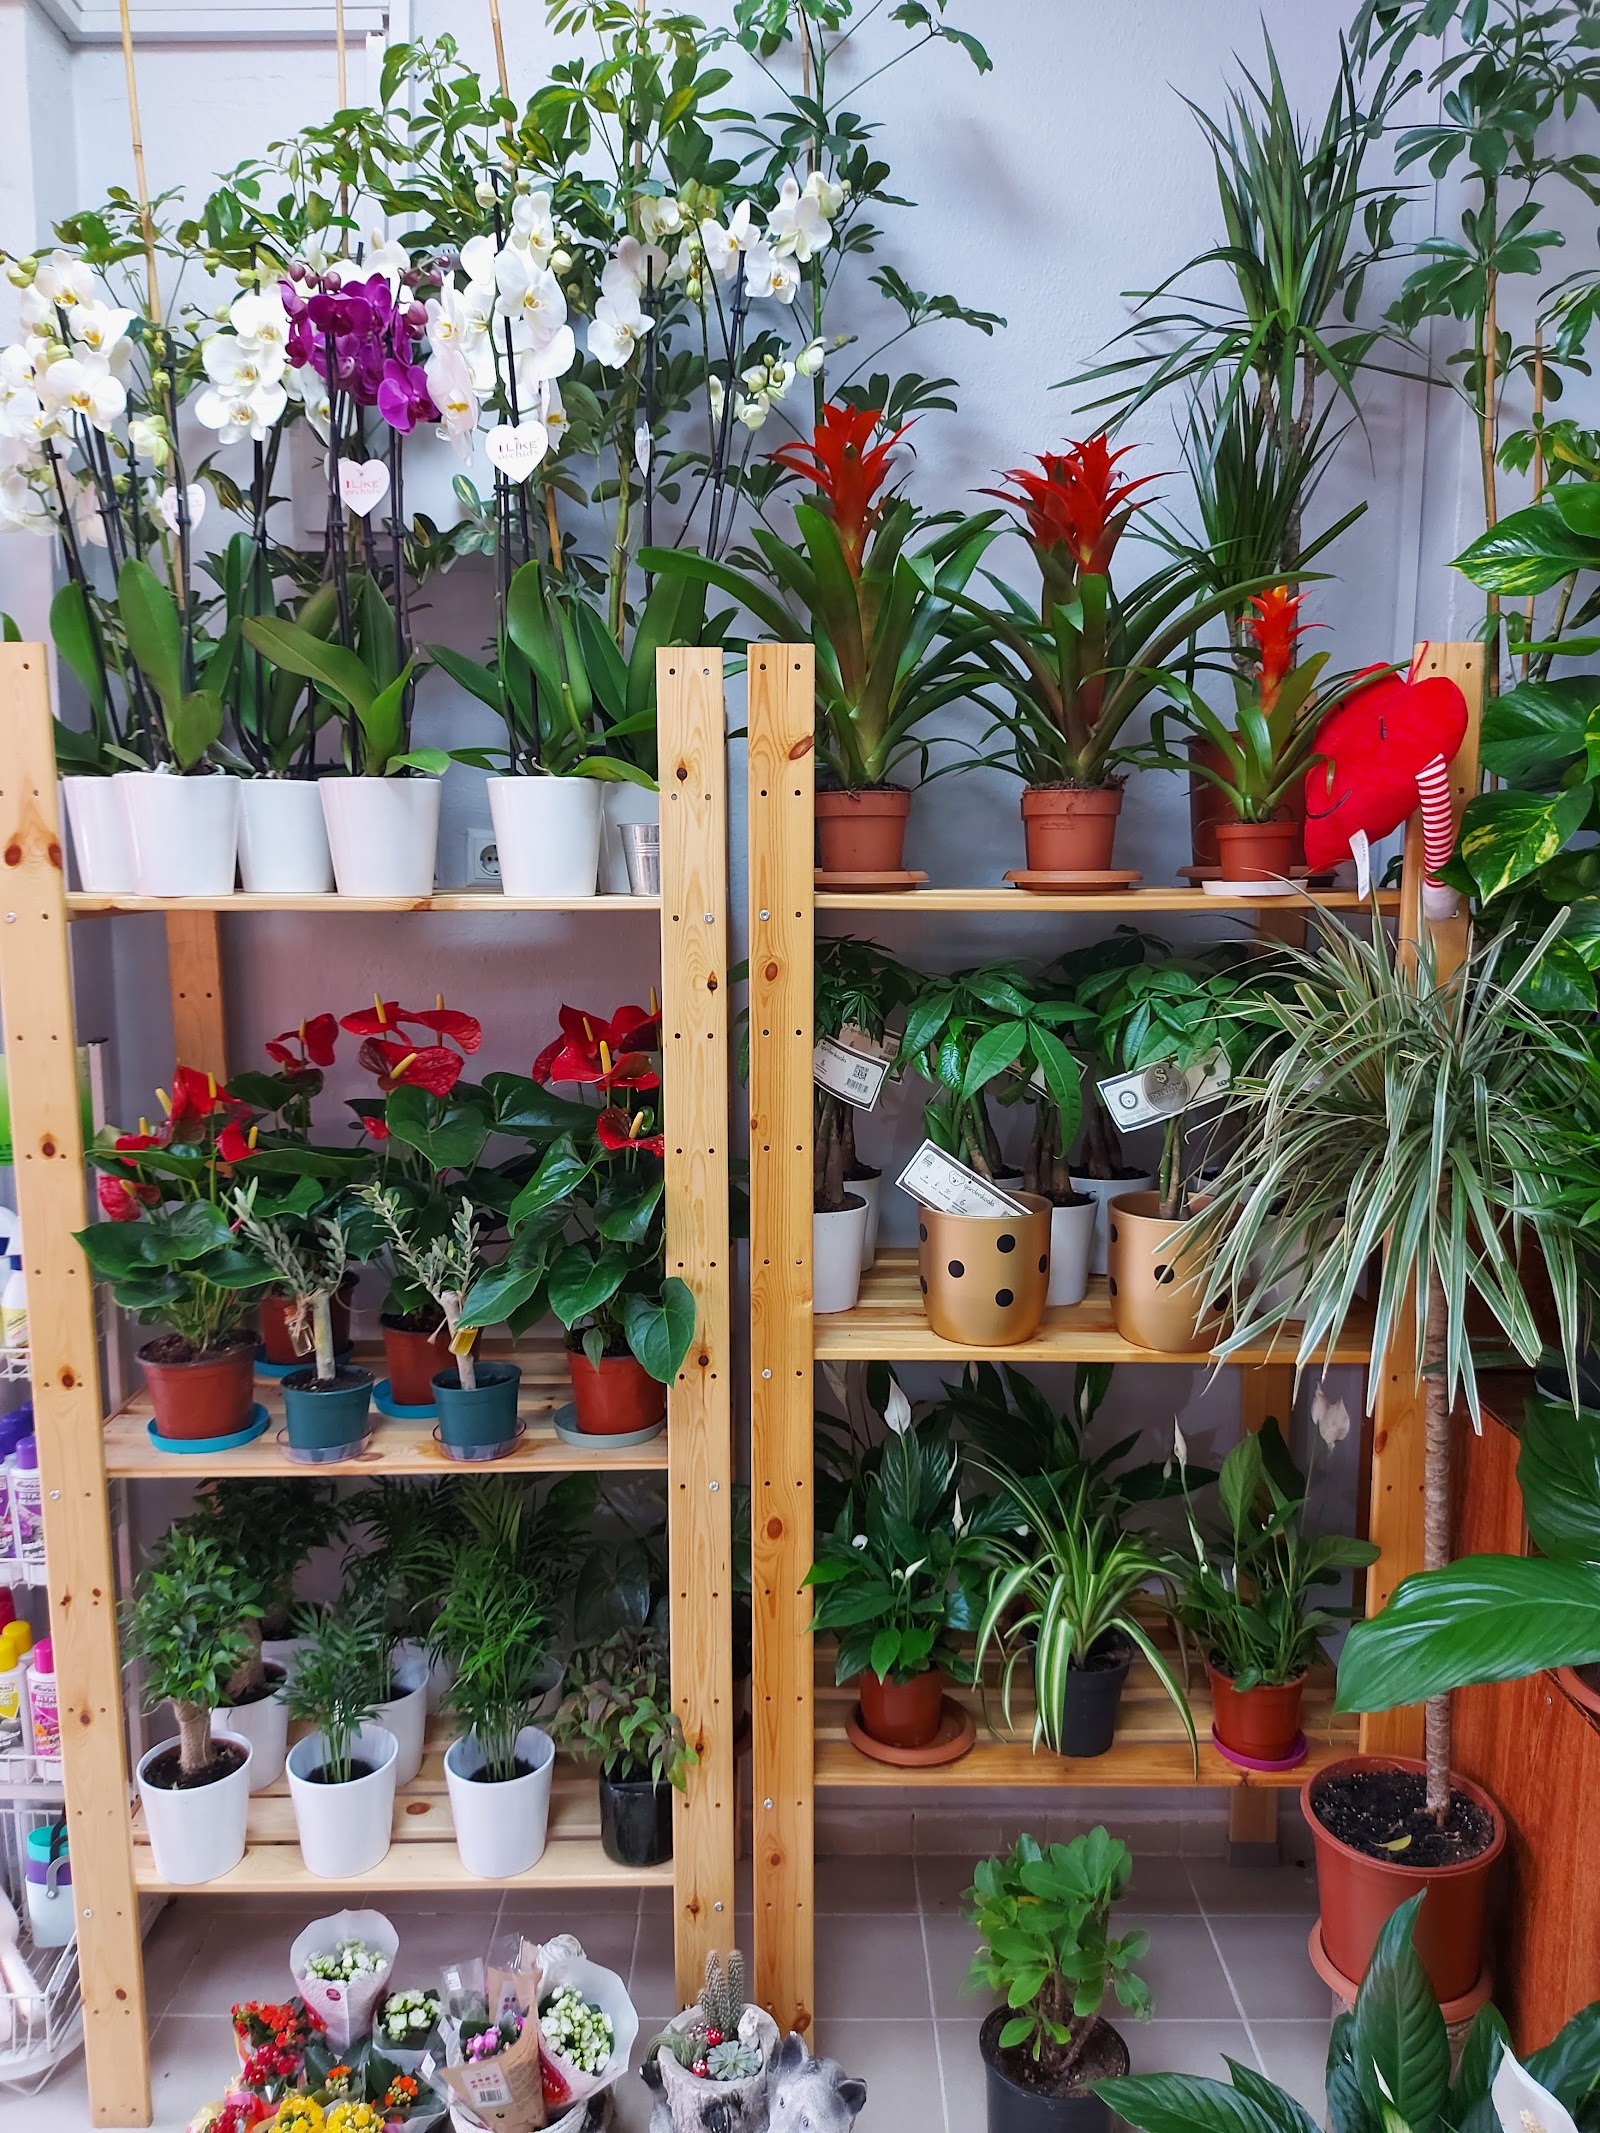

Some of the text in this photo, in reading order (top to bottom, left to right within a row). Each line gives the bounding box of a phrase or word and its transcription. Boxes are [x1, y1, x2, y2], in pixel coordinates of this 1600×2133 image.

[506, 441, 537, 451] LIKE
[498, 450, 539, 459] orchids
[352, 480, 380, 488] LIKE
